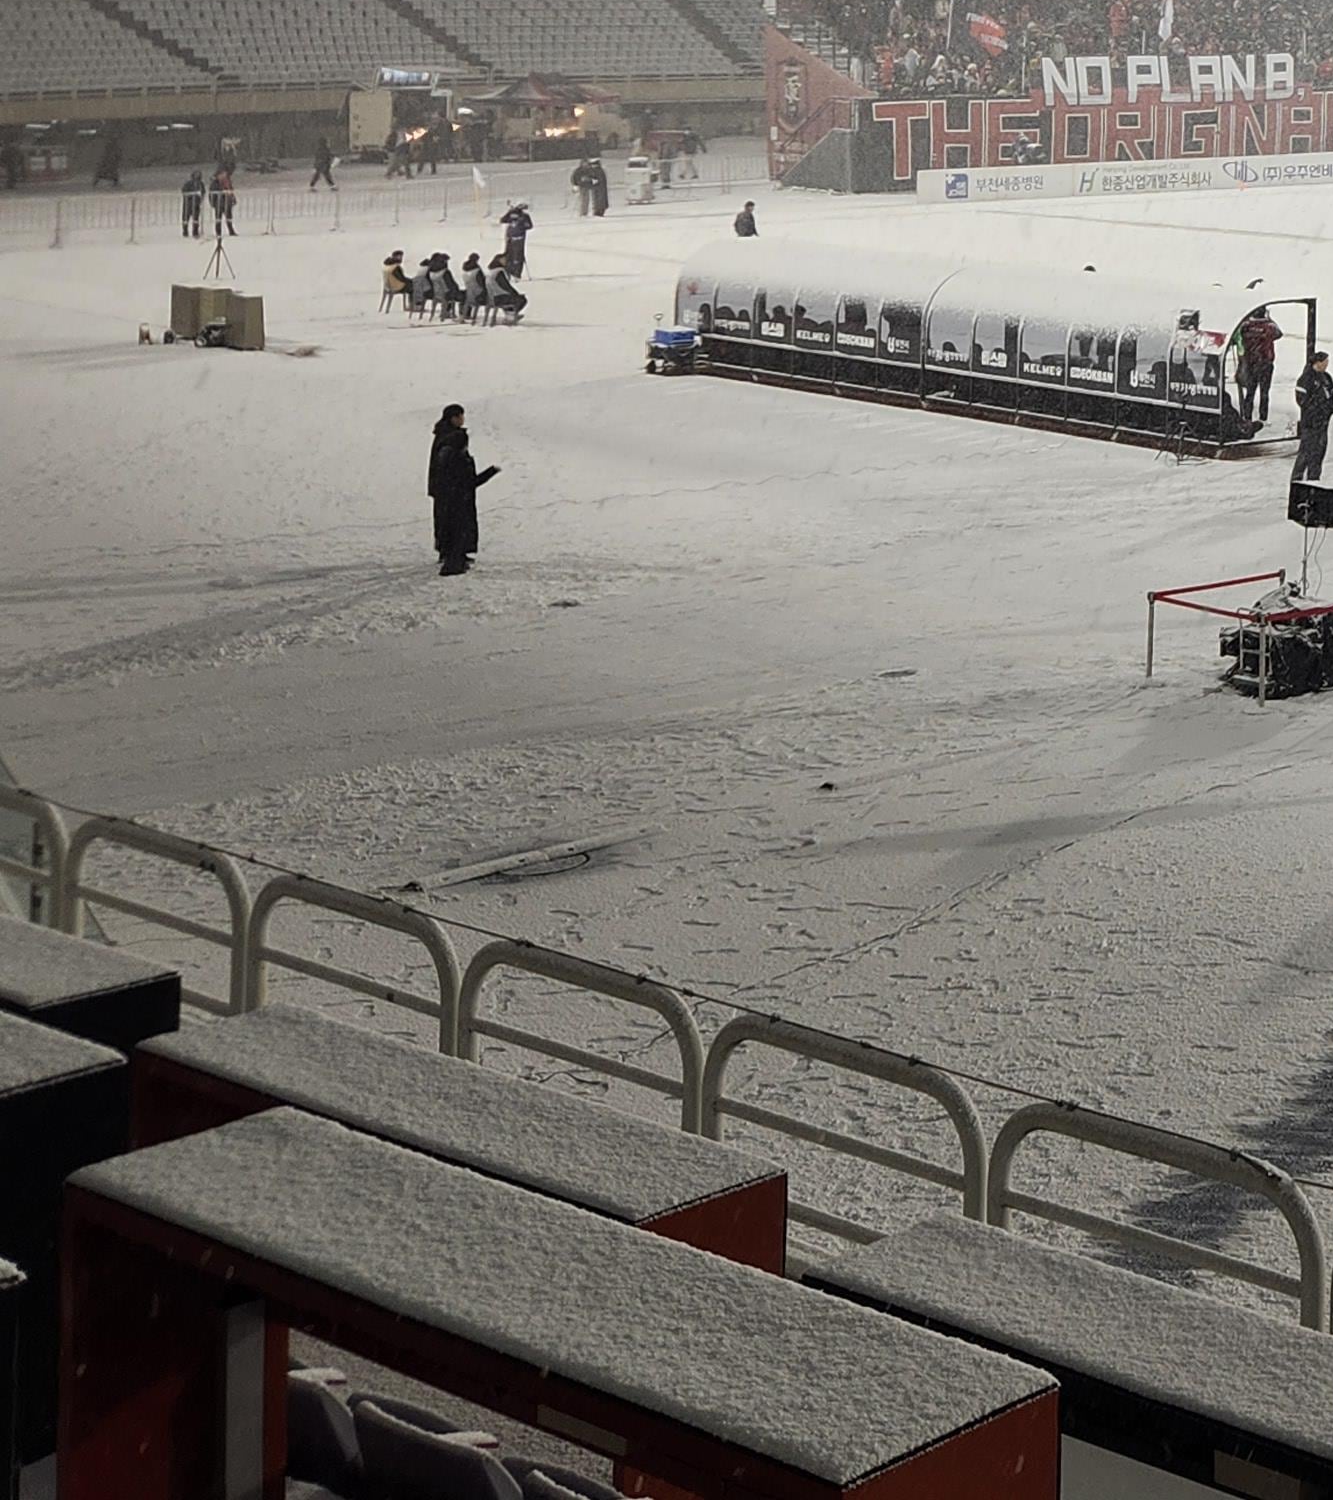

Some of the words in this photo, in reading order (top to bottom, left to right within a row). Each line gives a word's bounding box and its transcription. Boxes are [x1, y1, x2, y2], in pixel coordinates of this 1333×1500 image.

[1042, 56, 1112, 106] NO
[1127, 54, 1255, 103] PLAN
[1023, 362, 1055, 376] KELME
